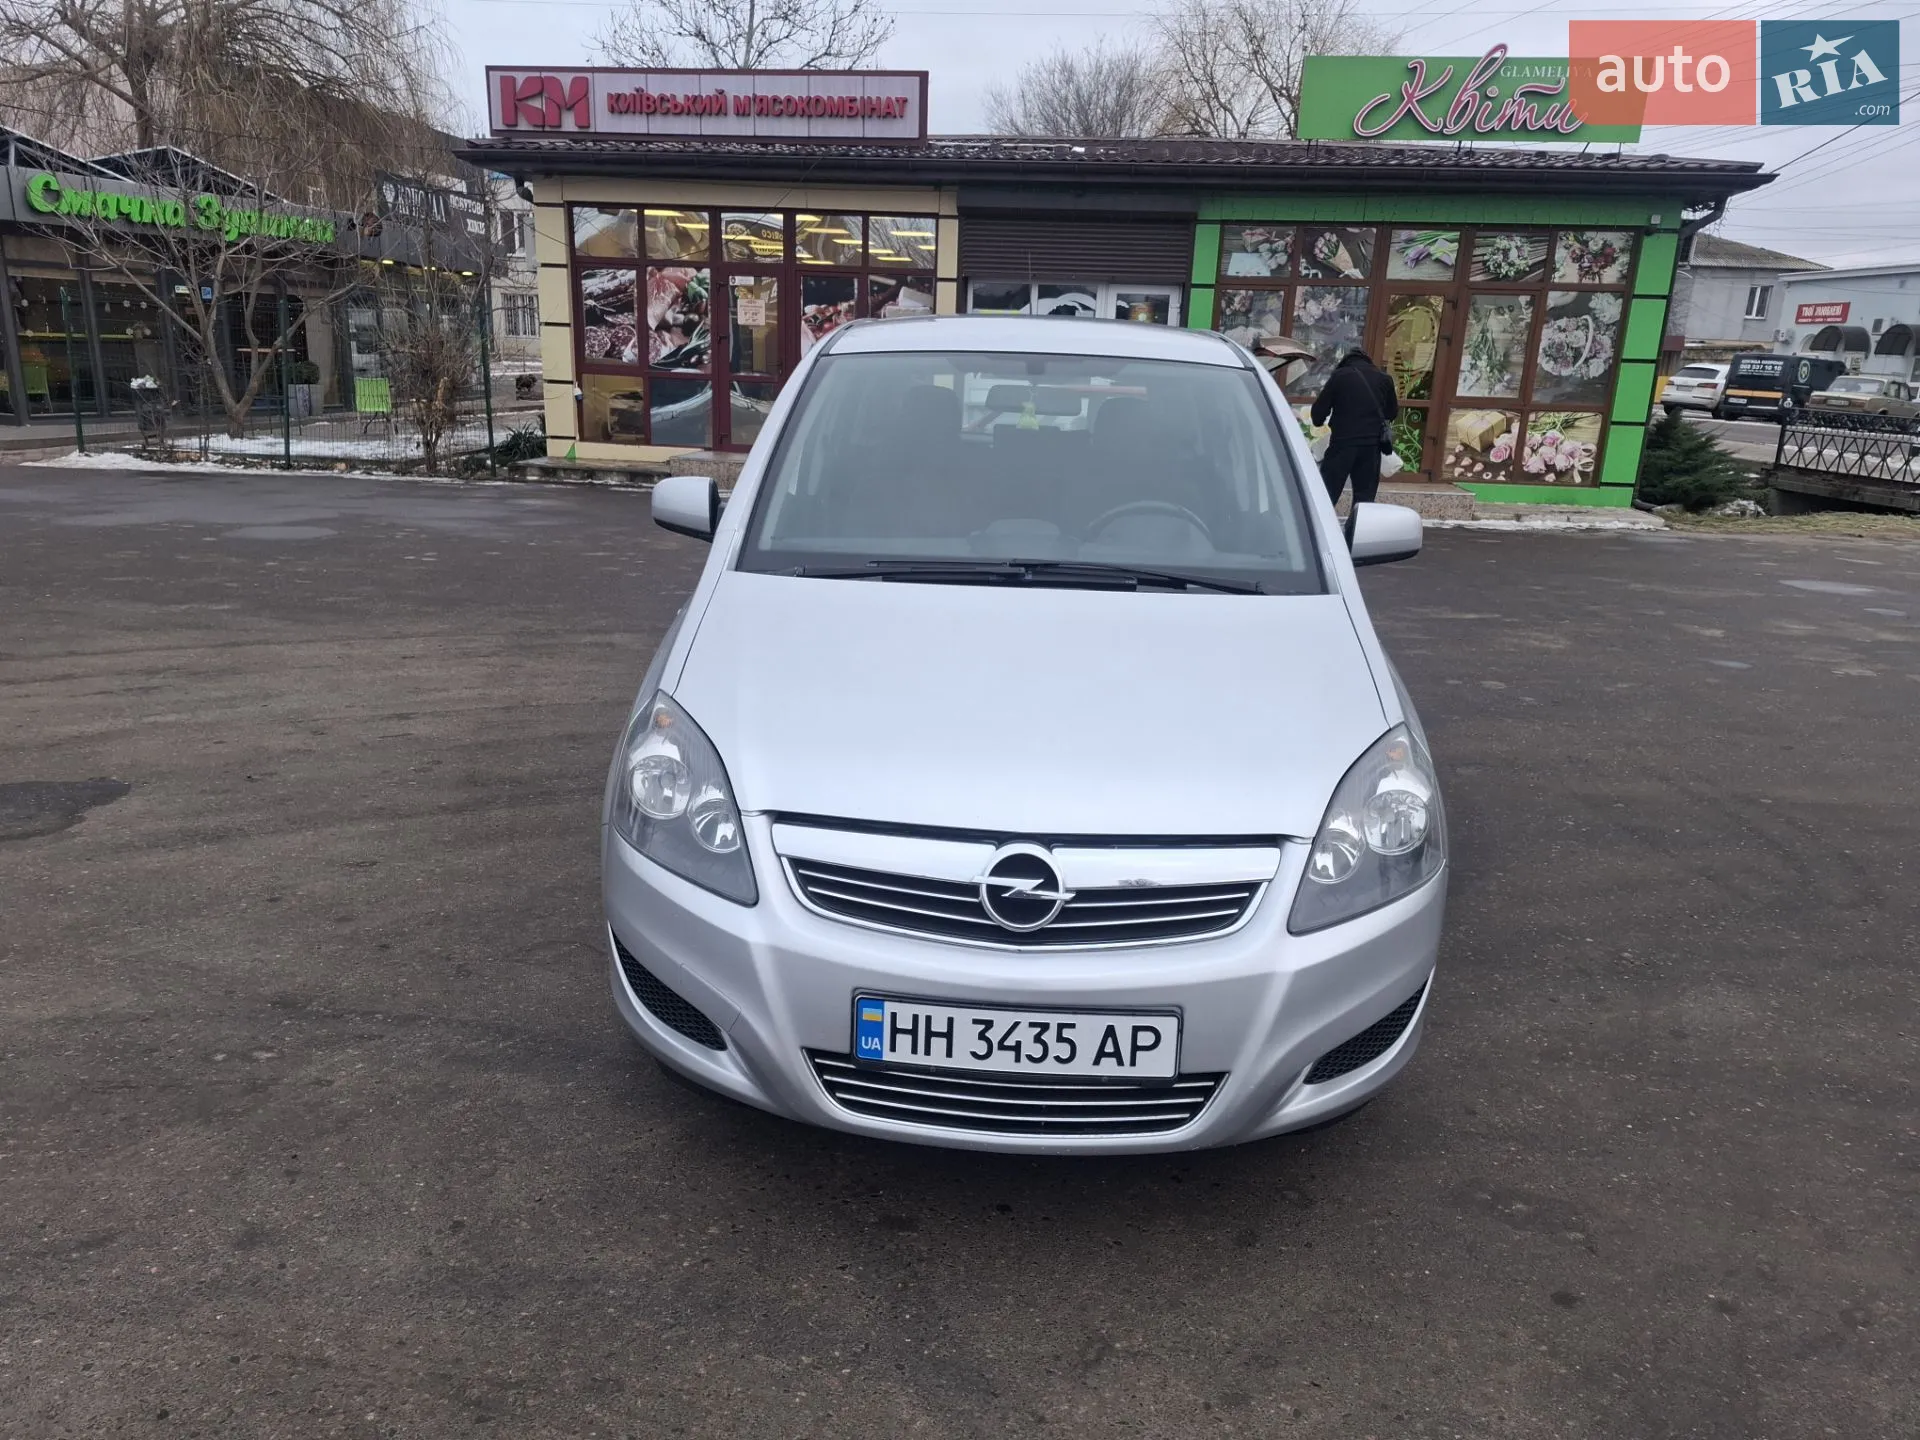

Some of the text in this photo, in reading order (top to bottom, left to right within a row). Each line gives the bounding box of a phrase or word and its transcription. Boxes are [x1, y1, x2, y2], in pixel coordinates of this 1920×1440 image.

[606, 86, 909, 119] КИЇВСЬКИЙ М'ЯСОКОМБІНАТ
[26, 172, 187, 227] Смачна
[861, 1036, 881, 1051] UA
[889, 1011, 1162, 1068] HH 3435 AP
